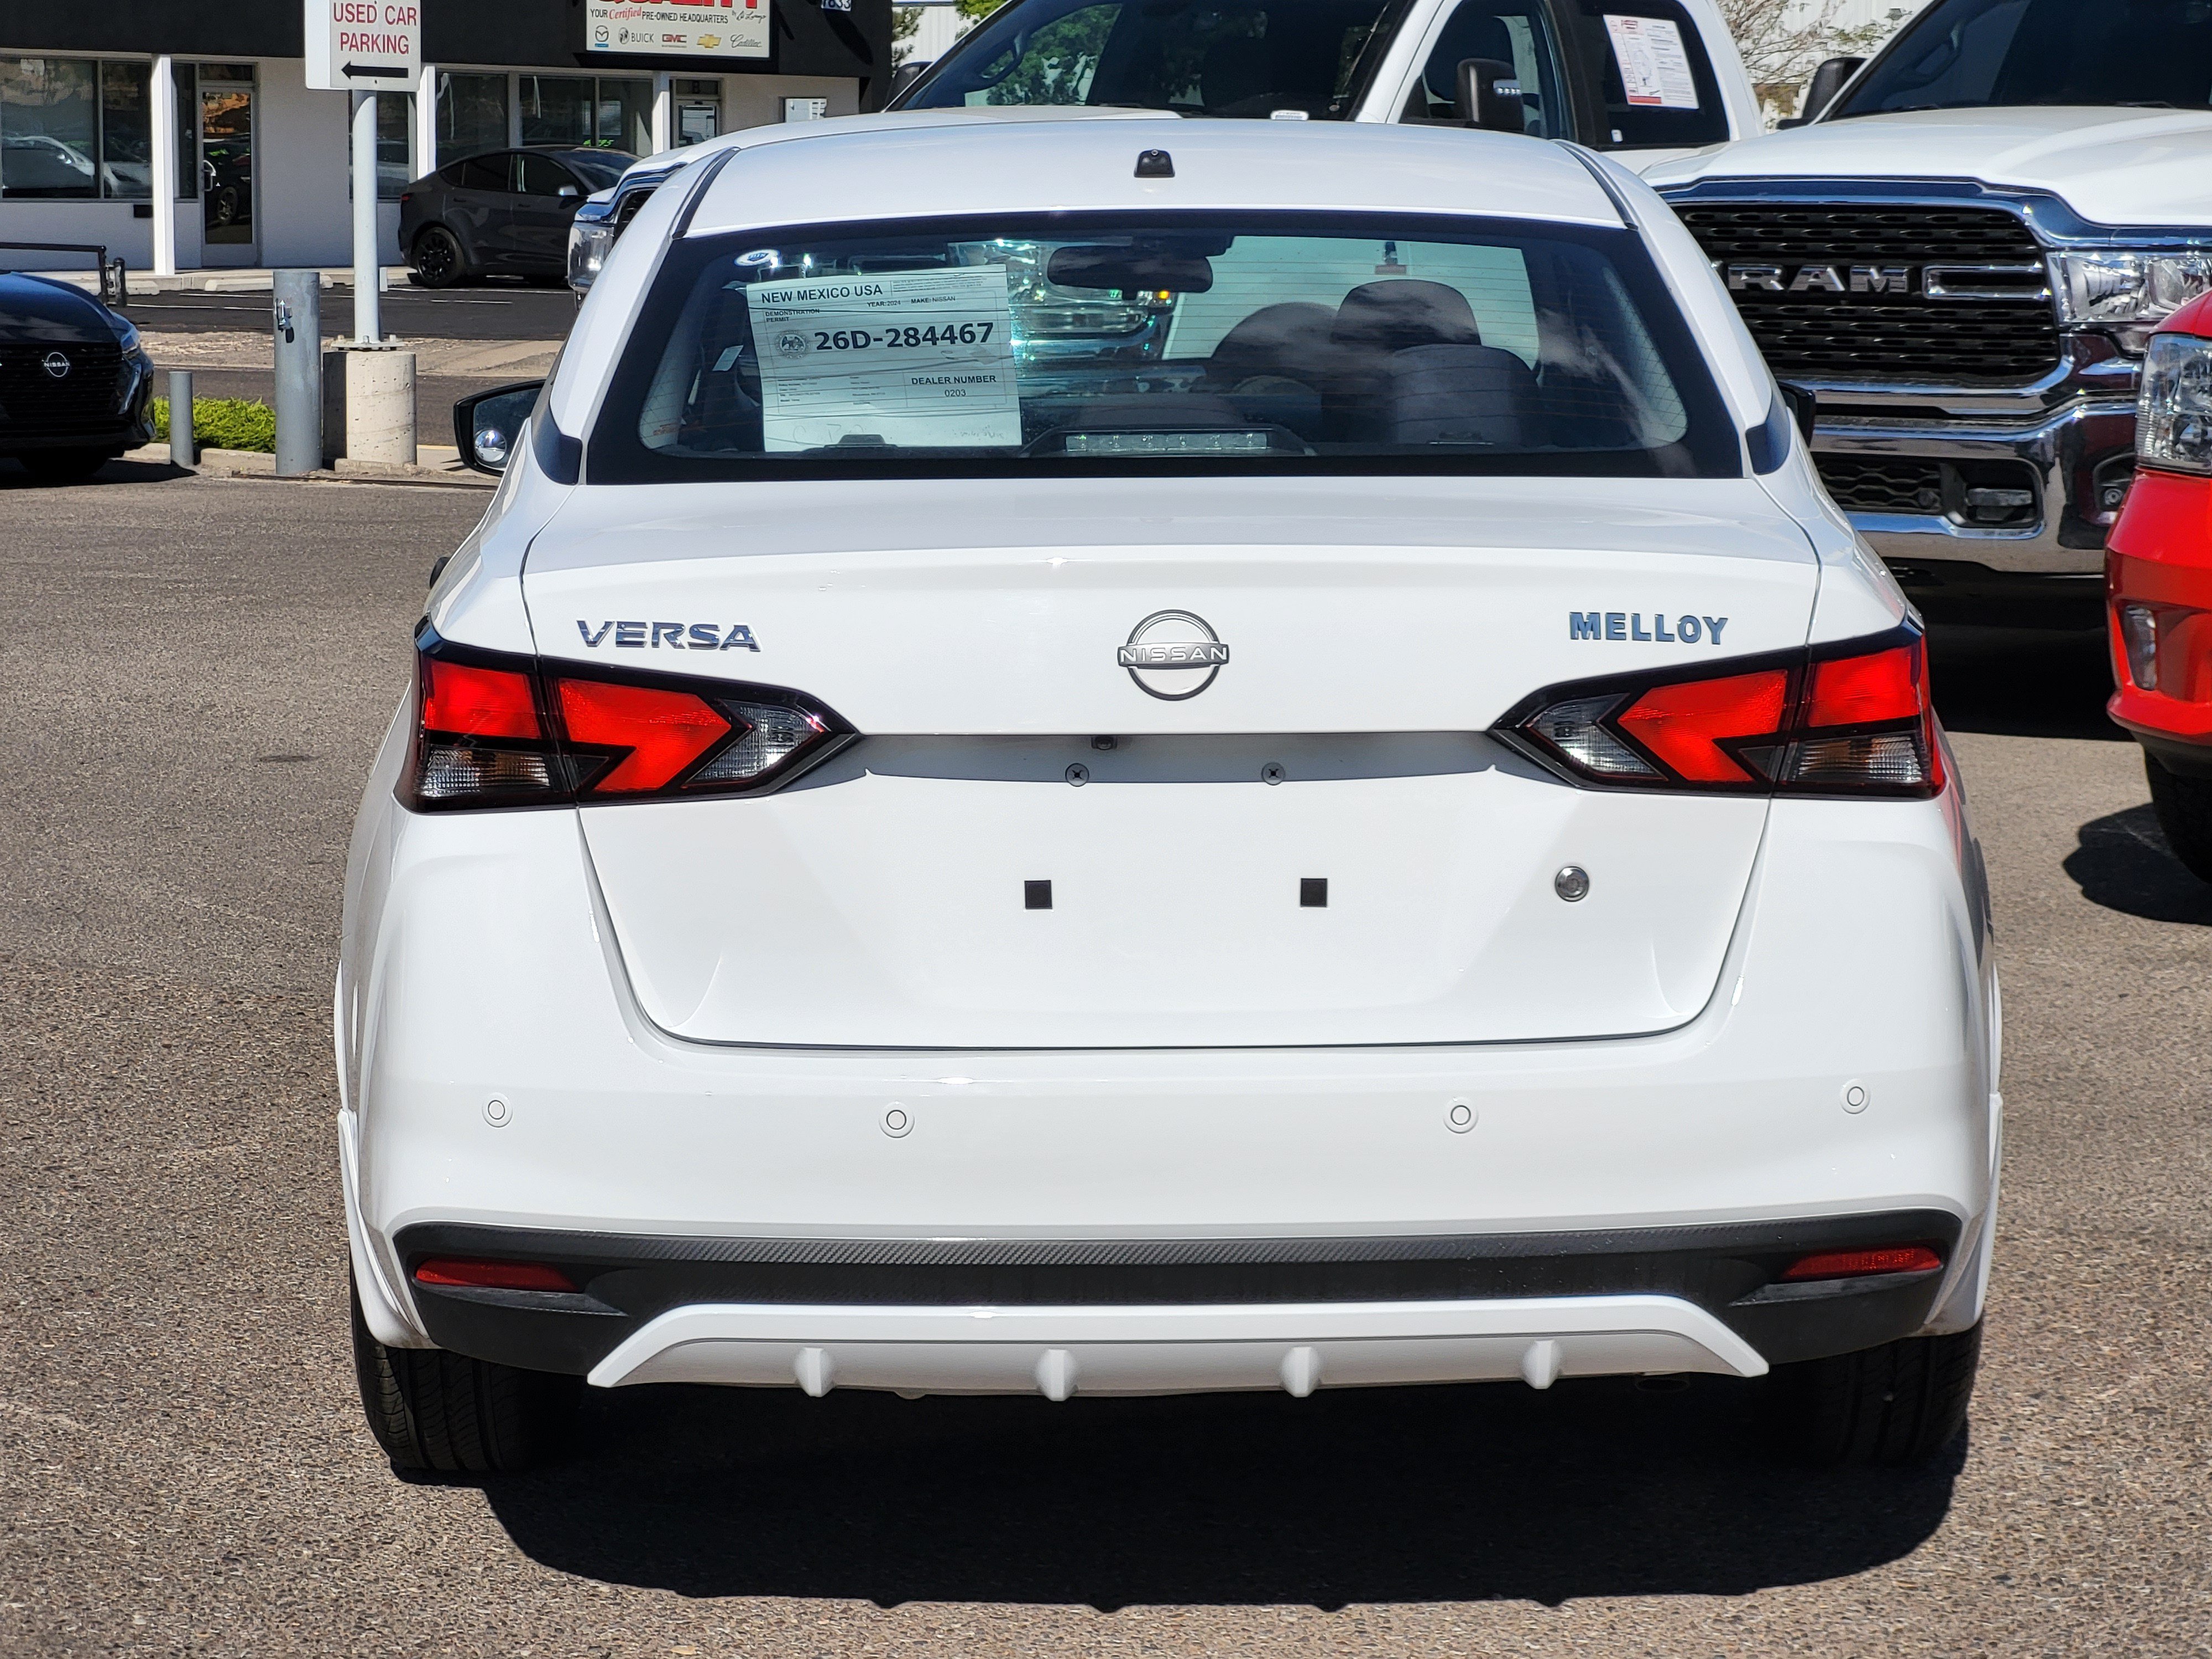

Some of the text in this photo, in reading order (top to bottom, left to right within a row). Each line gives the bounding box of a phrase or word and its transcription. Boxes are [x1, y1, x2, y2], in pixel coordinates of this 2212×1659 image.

[333, 3, 417, 26] USED CAR
[590, 8, 608, 18] YOUR
[609, 6, 641, 20] Certified
[642, 11, 677, 21] PRE-OWNED
[680, 13, 728, 24] HEADQUARTERS
[340, 32, 409, 54] PARKING
[631, 33, 654, 43] BUICK
[662, 34, 687, 43] GMC
[1728, 264, 1908, 293] RAM
[761, 291, 792, 304] NEW
[797, 287, 850, 301] MEXICO
[854, 284, 883, 296] USA
[814, 322, 994, 350] 26D-284467
[911, 375, 997, 385] DEALER NUMBER
[945, 389, 966, 398] 0203
[576, 620, 761, 652] VERSA
[1569, 612, 1729, 645] MELLOY
[1119, 646, 1228, 662] NISSAN
